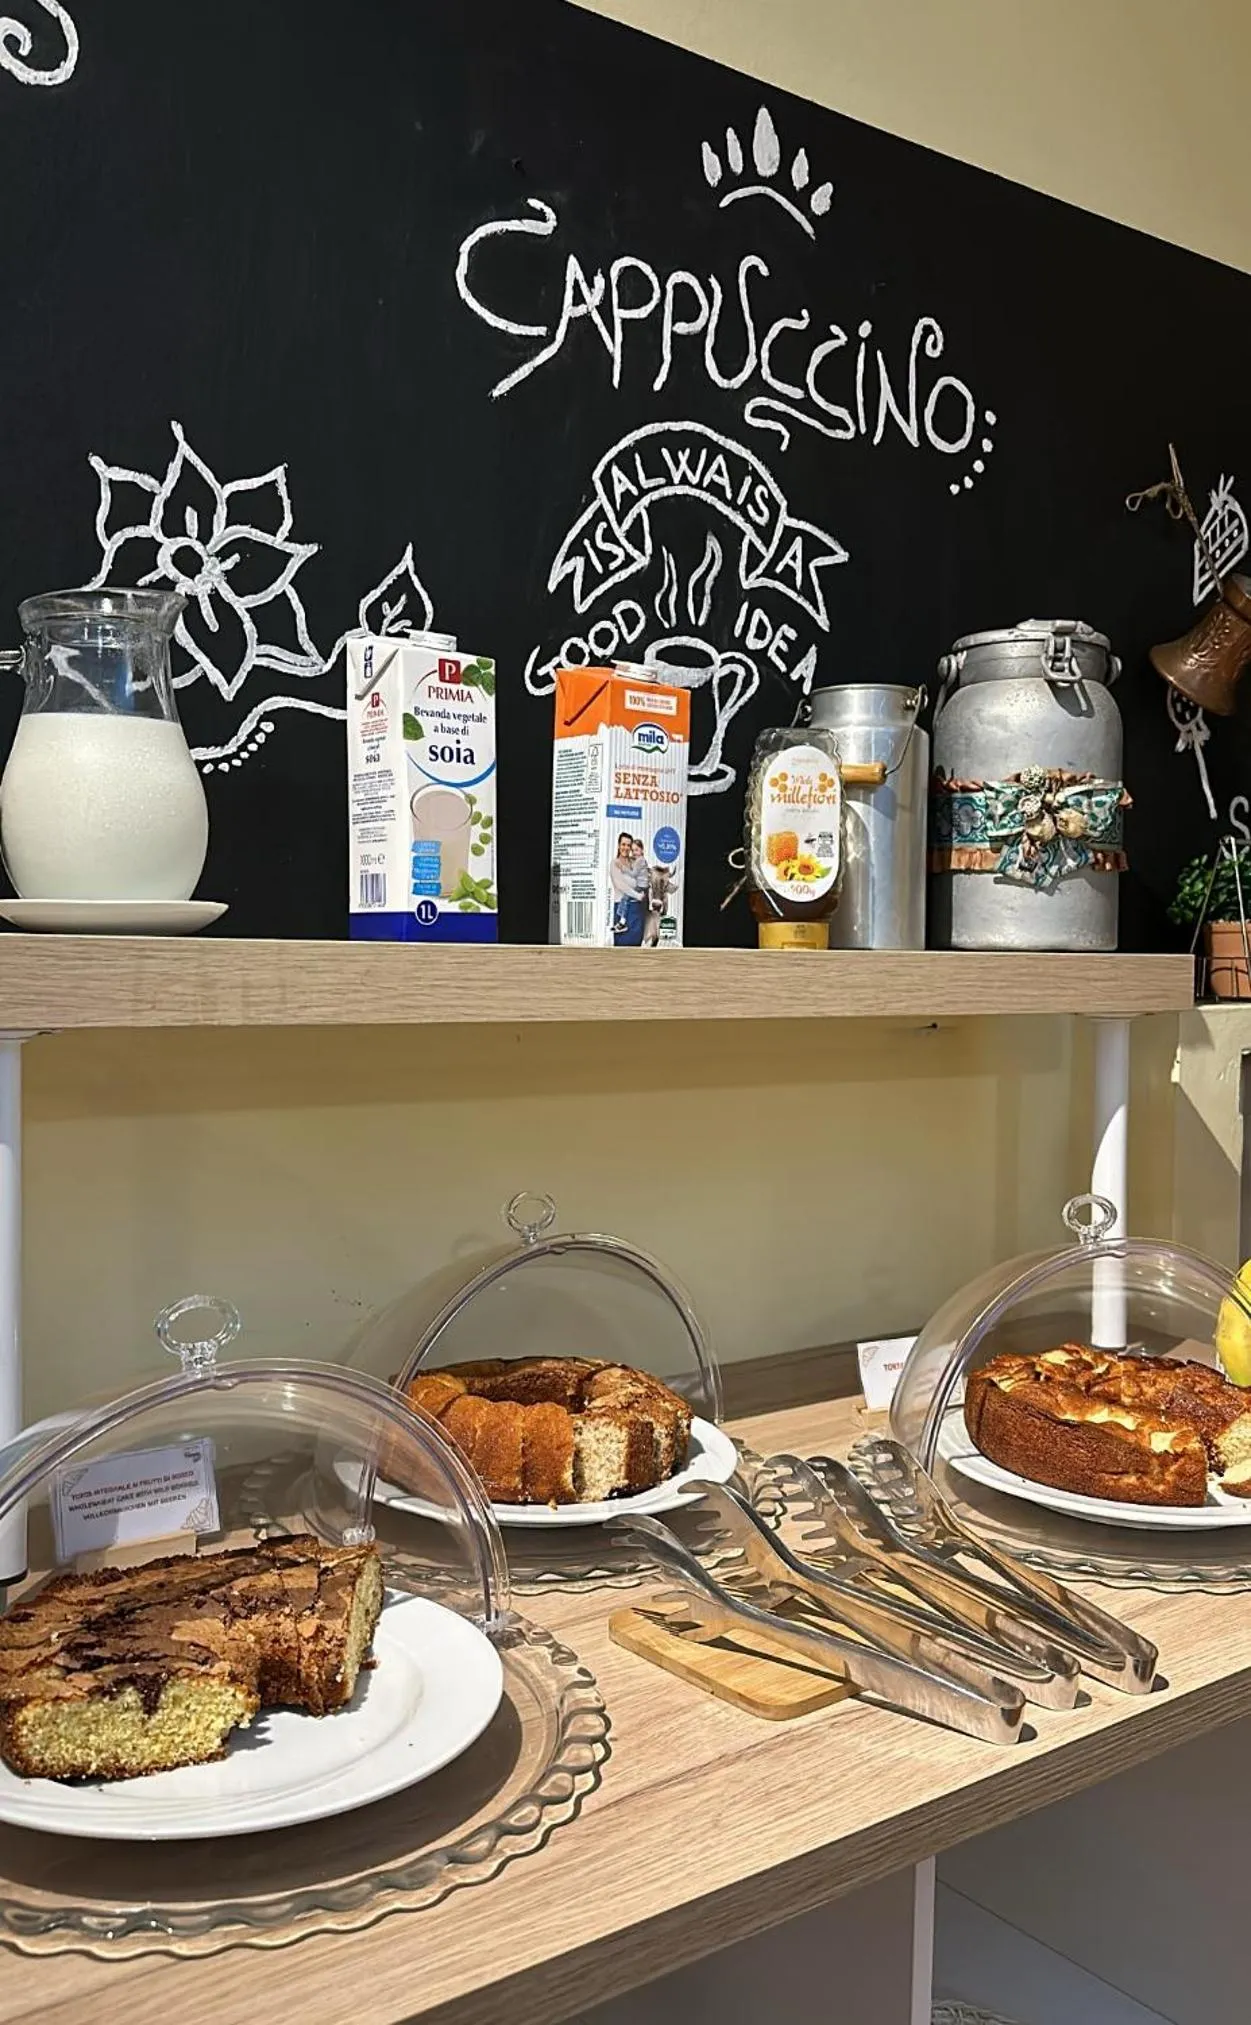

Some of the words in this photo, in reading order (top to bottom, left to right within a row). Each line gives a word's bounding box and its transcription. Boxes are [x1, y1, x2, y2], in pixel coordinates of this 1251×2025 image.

[776, 536, 803, 590] A
[525, 600, 646, 697] GOOD
[733, 600, 818, 696] IDEA
[427, 685, 474, 704] PRIMIA
[413, 705, 451, 720] Bevanda
[452, 712, 488, 724] vegetale
[440, 723, 460, 735] base
[461, 726, 470, 736] di
[637, 730, 665, 745] mila
[428, 739, 476, 765] soia
[614, 772, 658, 787] SENZA
[420, 904, 434, 920] 1L
